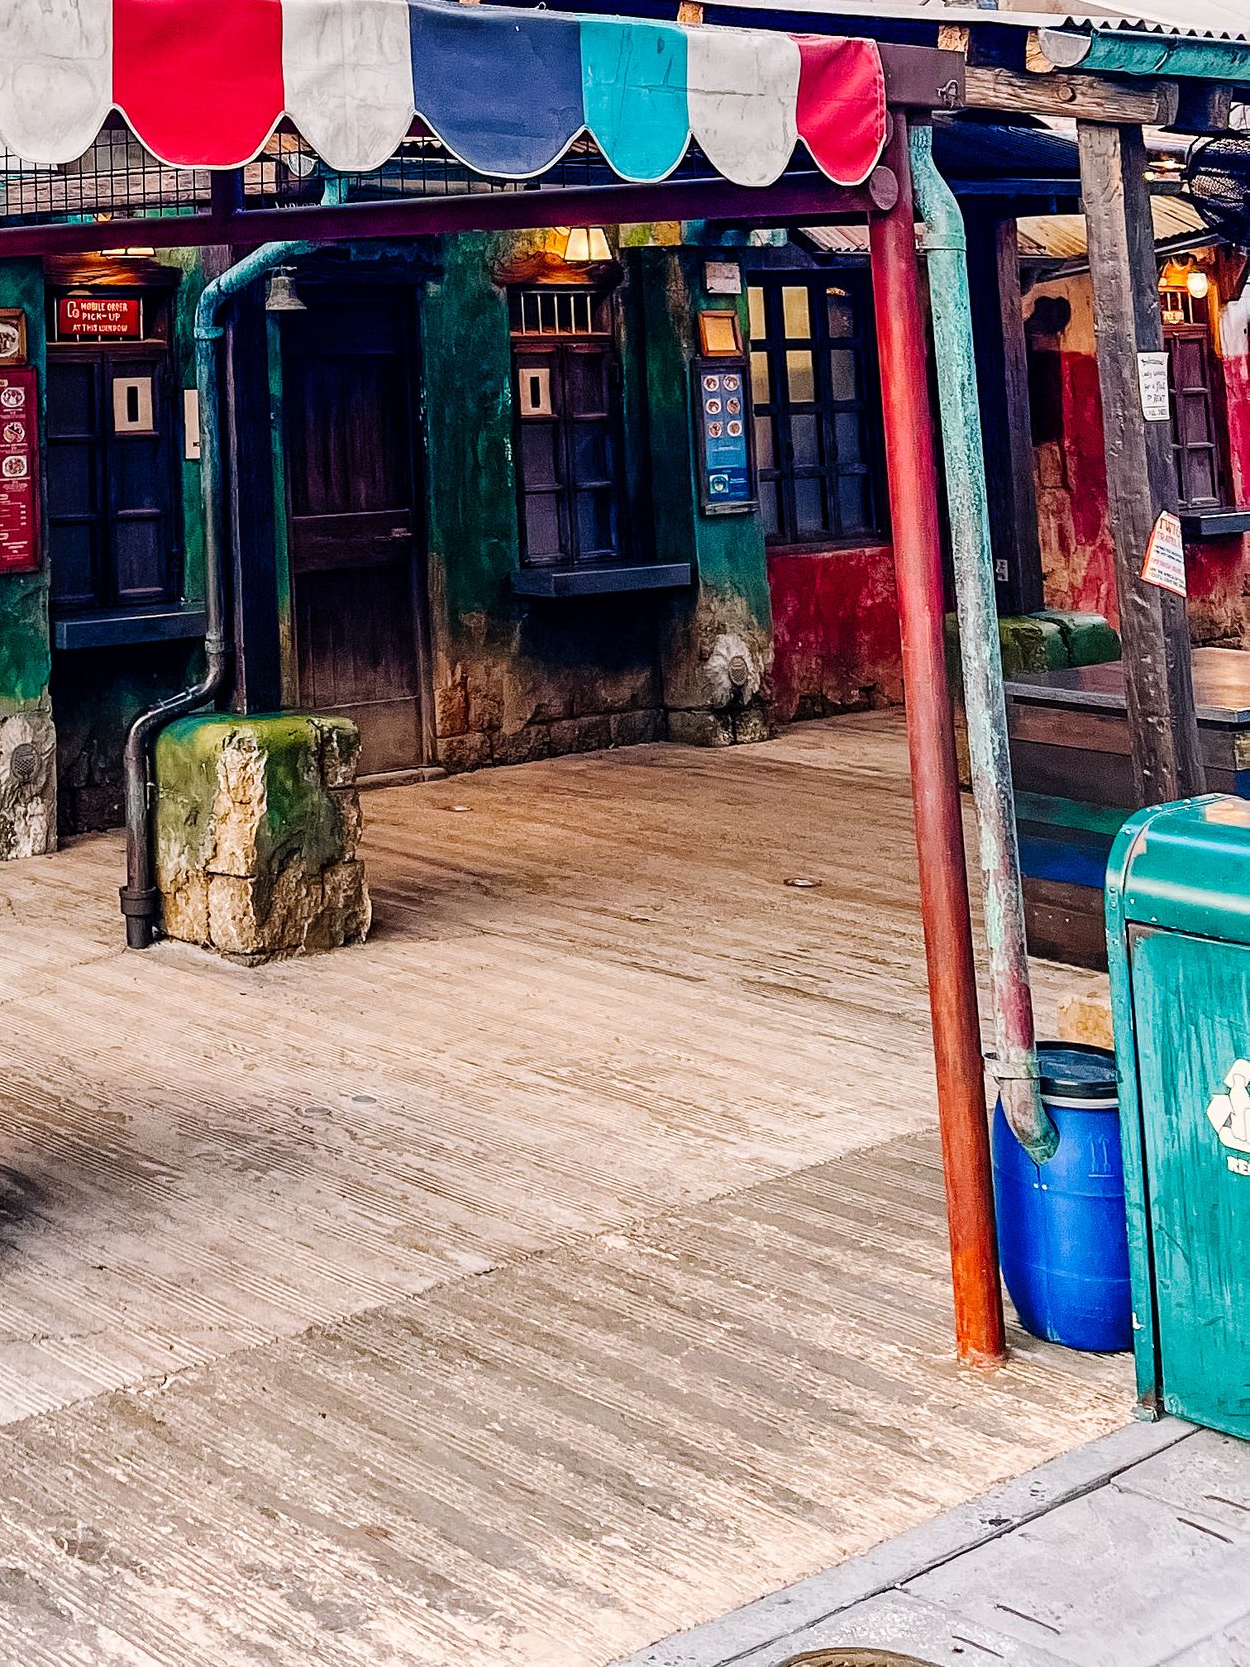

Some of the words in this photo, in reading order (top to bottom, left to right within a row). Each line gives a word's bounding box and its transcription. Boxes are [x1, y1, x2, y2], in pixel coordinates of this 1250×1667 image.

[80, 302, 105, 312] MOBILE
[106, 303, 128, 312] ORDER
[82, 312, 121, 321] PICK-UP
[72, 324, 81, 332] AT
[82, 324, 98, 332] THIS
[98, 324, 128, 332] WINDOW
